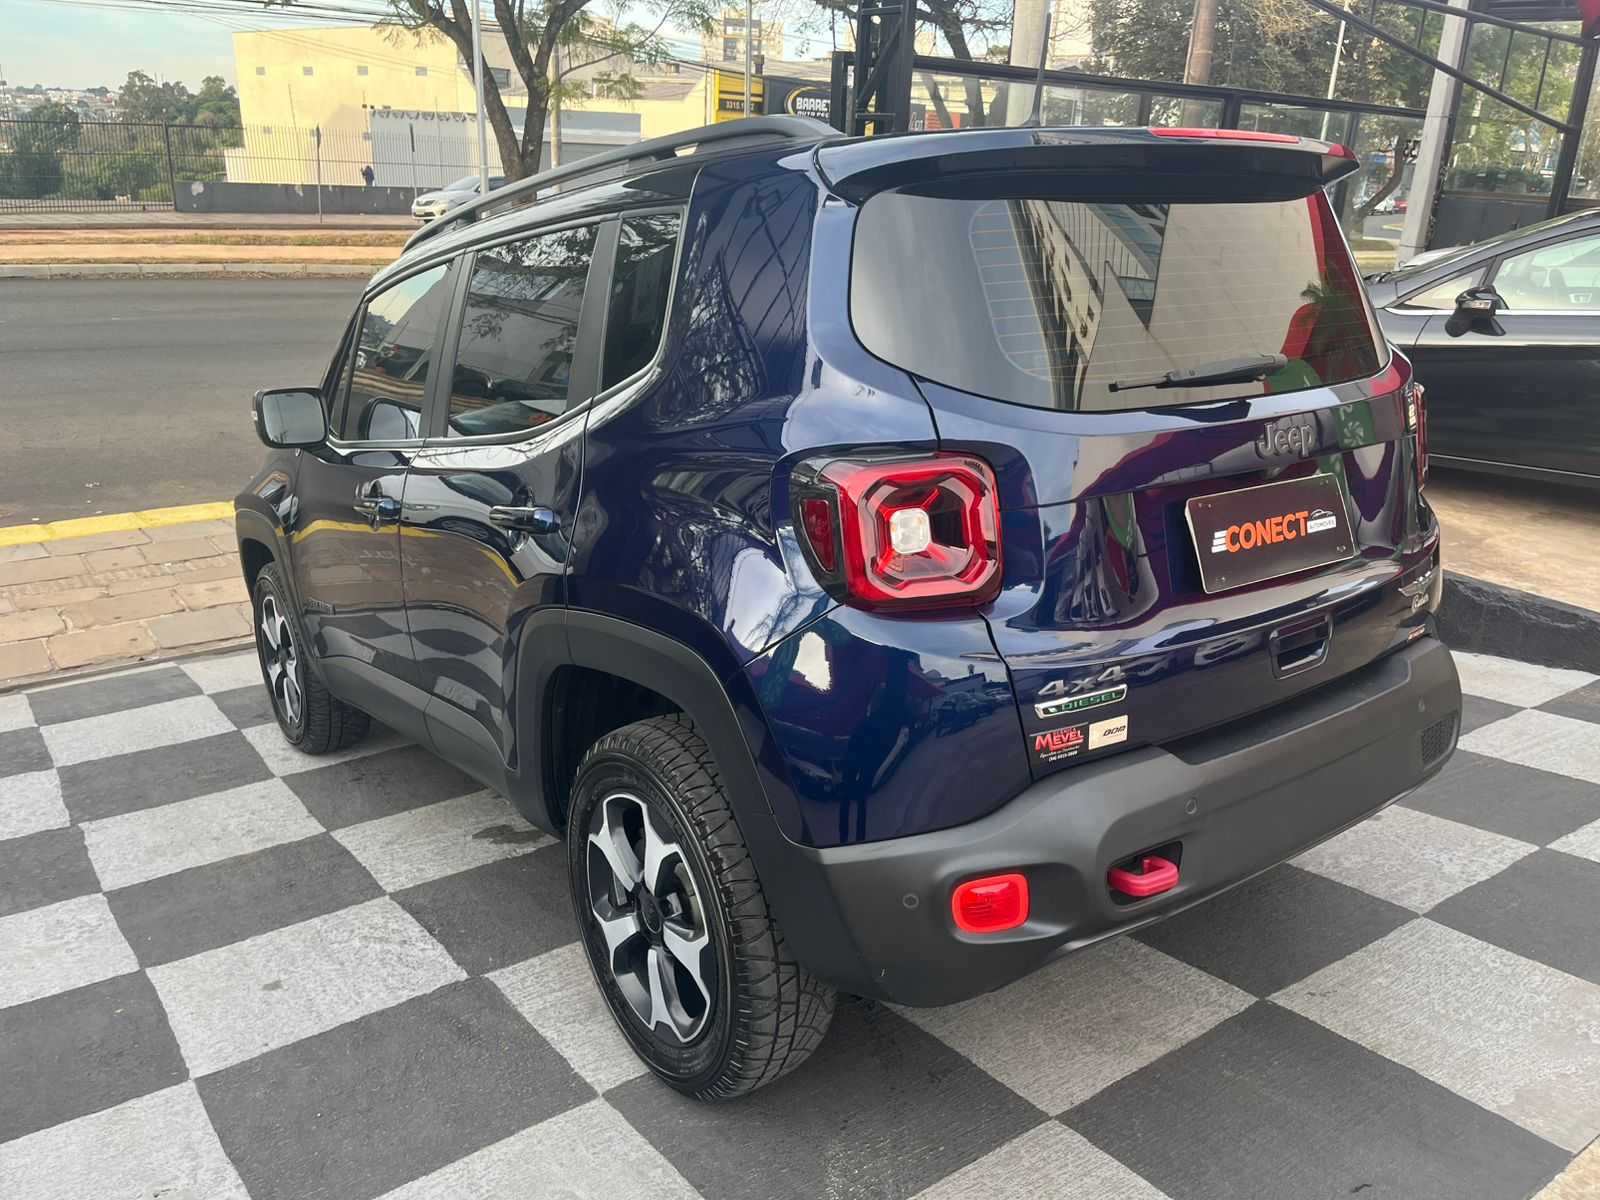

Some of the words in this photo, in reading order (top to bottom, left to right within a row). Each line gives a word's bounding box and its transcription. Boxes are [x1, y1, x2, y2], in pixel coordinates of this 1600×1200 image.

[1257, 423, 1315, 457] Jeep
[1225, 511, 1309, 552] CONECT
[1038, 665, 1126, 695] 4x4
[1061, 691, 1121, 711] DIESEL
